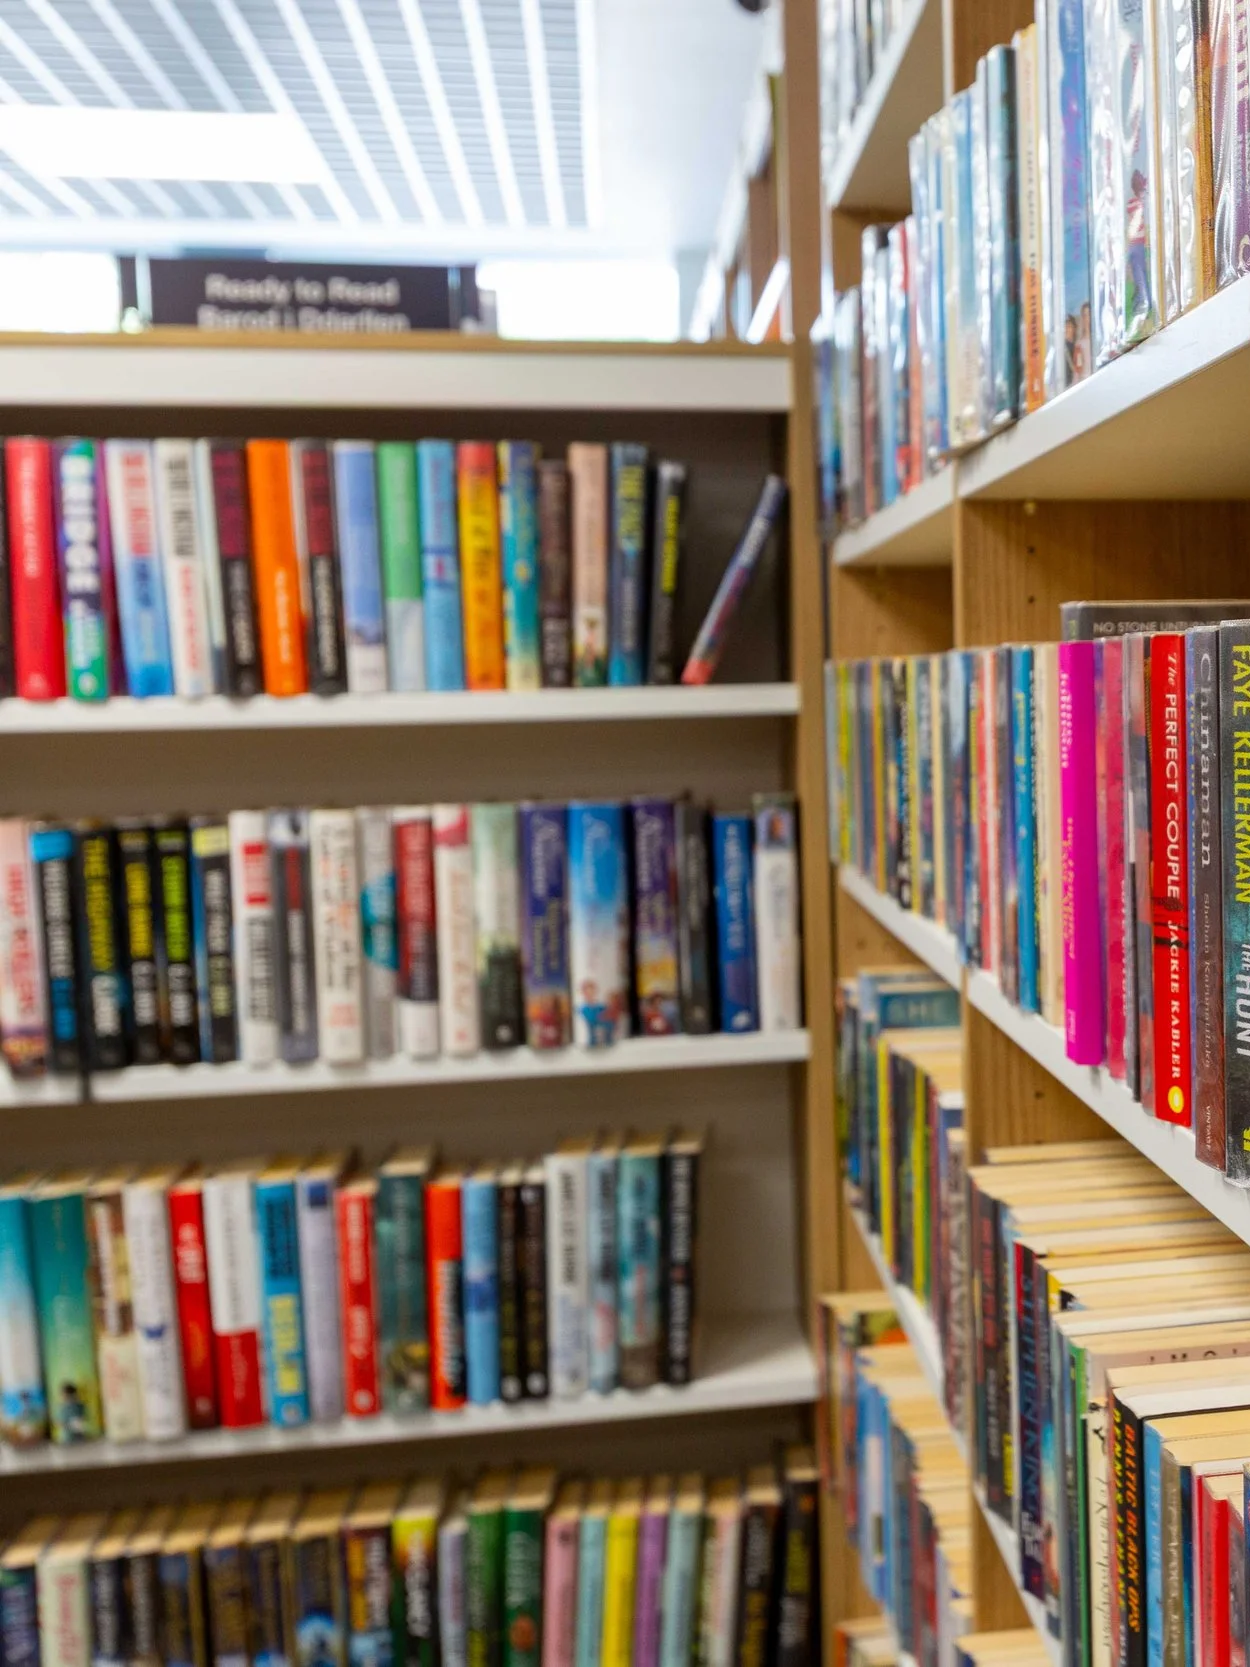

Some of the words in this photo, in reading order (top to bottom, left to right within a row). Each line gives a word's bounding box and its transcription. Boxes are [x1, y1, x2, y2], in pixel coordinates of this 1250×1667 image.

[205, 273, 291, 305] Ready
[295, 276, 326, 304] to
[328, 276, 399, 306] Read
[1093, 622, 1113, 634] NO
[1117, 620, 1158, 633] STONE
[1167, 652, 1178, 685] The
[1164, 693, 1180, 793] PERFECT
[1166, 802, 1181, 898] COUPLE
[1168, 920, 1181, 993] JACKIE
[1170, 1001, 1182, 1079] KABLER
[1125, 1424, 1137, 1508] BALTIC
[1127, 1509, 1140, 1584] BLACK
[1128, 1585, 1141, 1633] OPS
